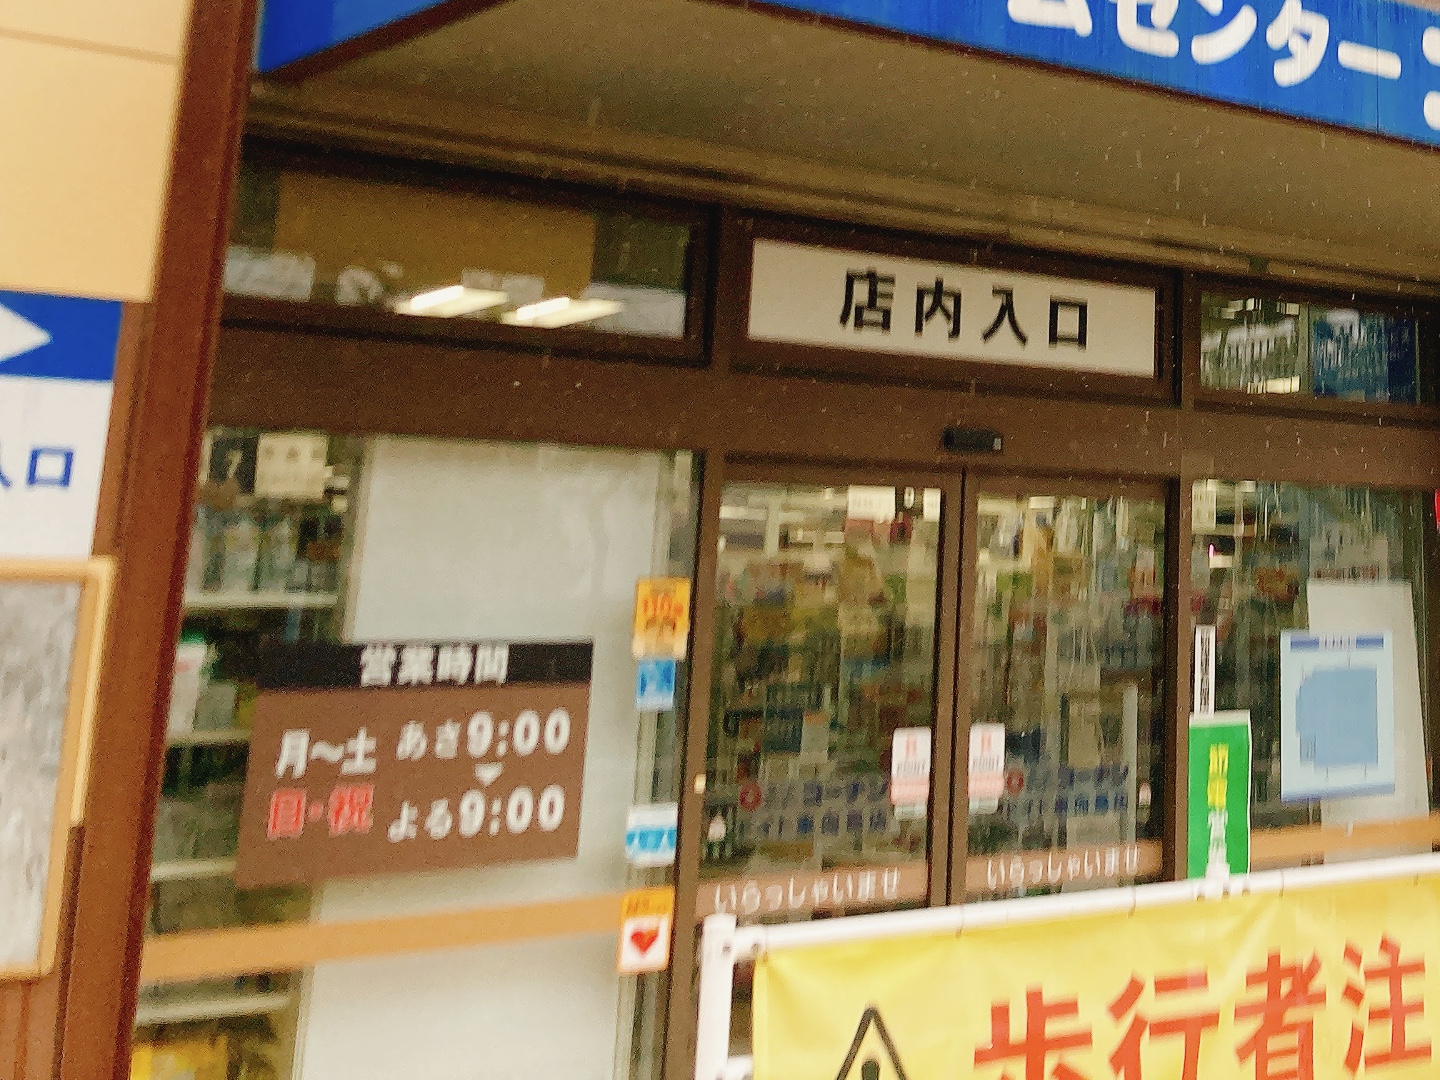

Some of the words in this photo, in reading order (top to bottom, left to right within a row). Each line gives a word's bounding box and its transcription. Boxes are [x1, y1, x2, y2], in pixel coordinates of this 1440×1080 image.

[840, 266, 1088, 351] 店内入口
[0, 442, 74, 490] 口
[359, 641, 509, 688] 営業時間
